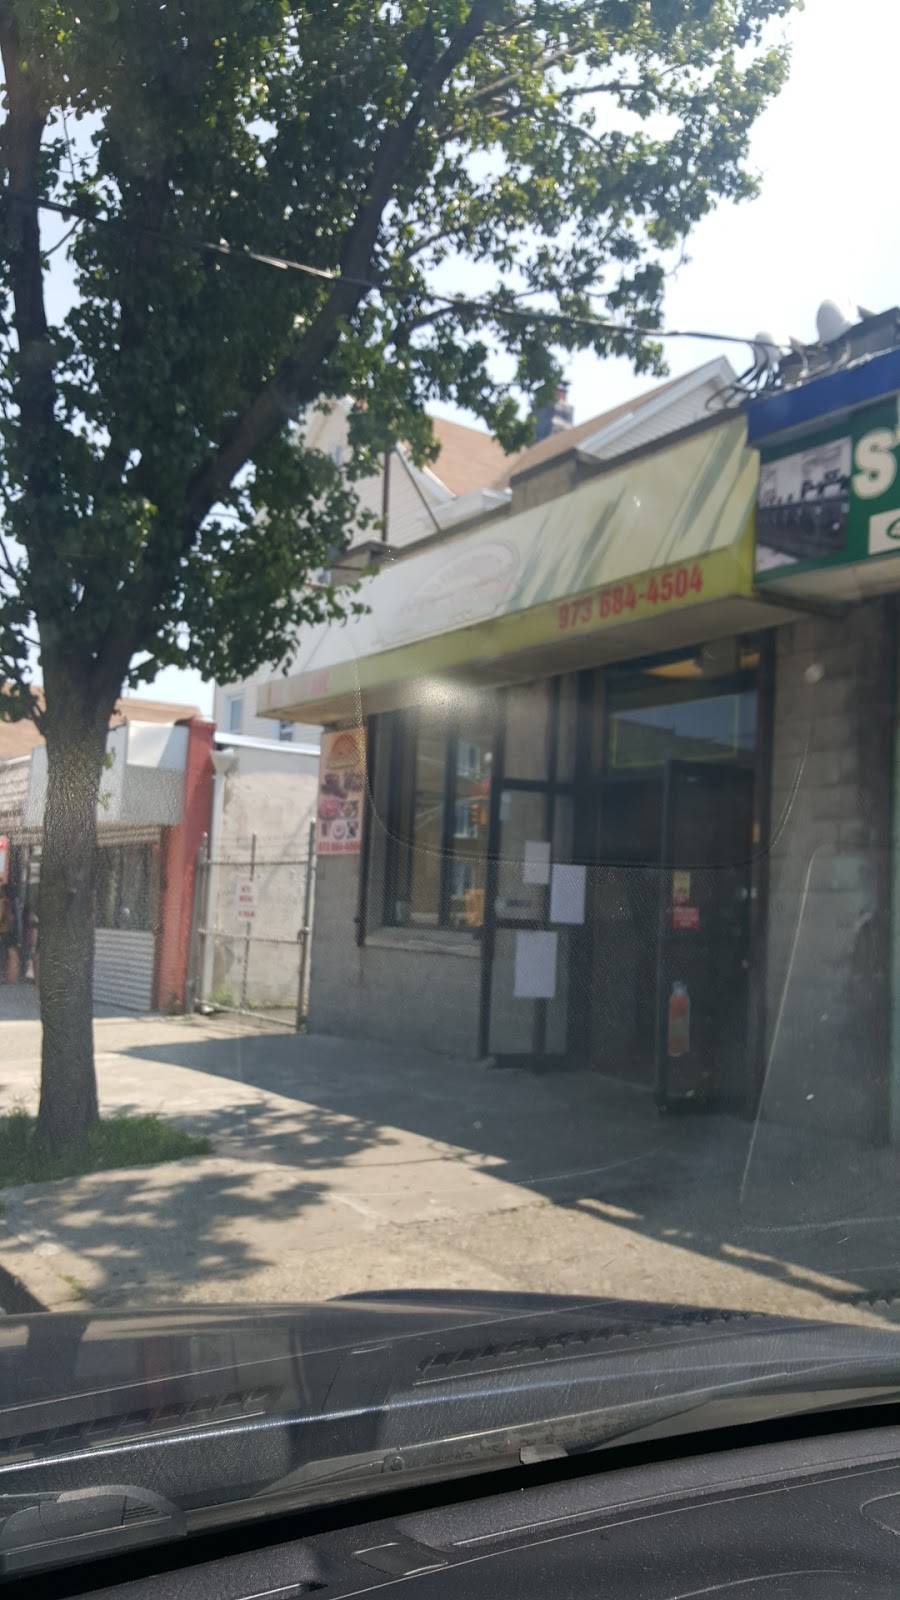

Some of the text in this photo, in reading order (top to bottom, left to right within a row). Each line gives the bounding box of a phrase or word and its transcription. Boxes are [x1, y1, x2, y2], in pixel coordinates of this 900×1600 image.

[852, 398, 900, 499] S
[558, 564, 704, 629] 973 684-4504
